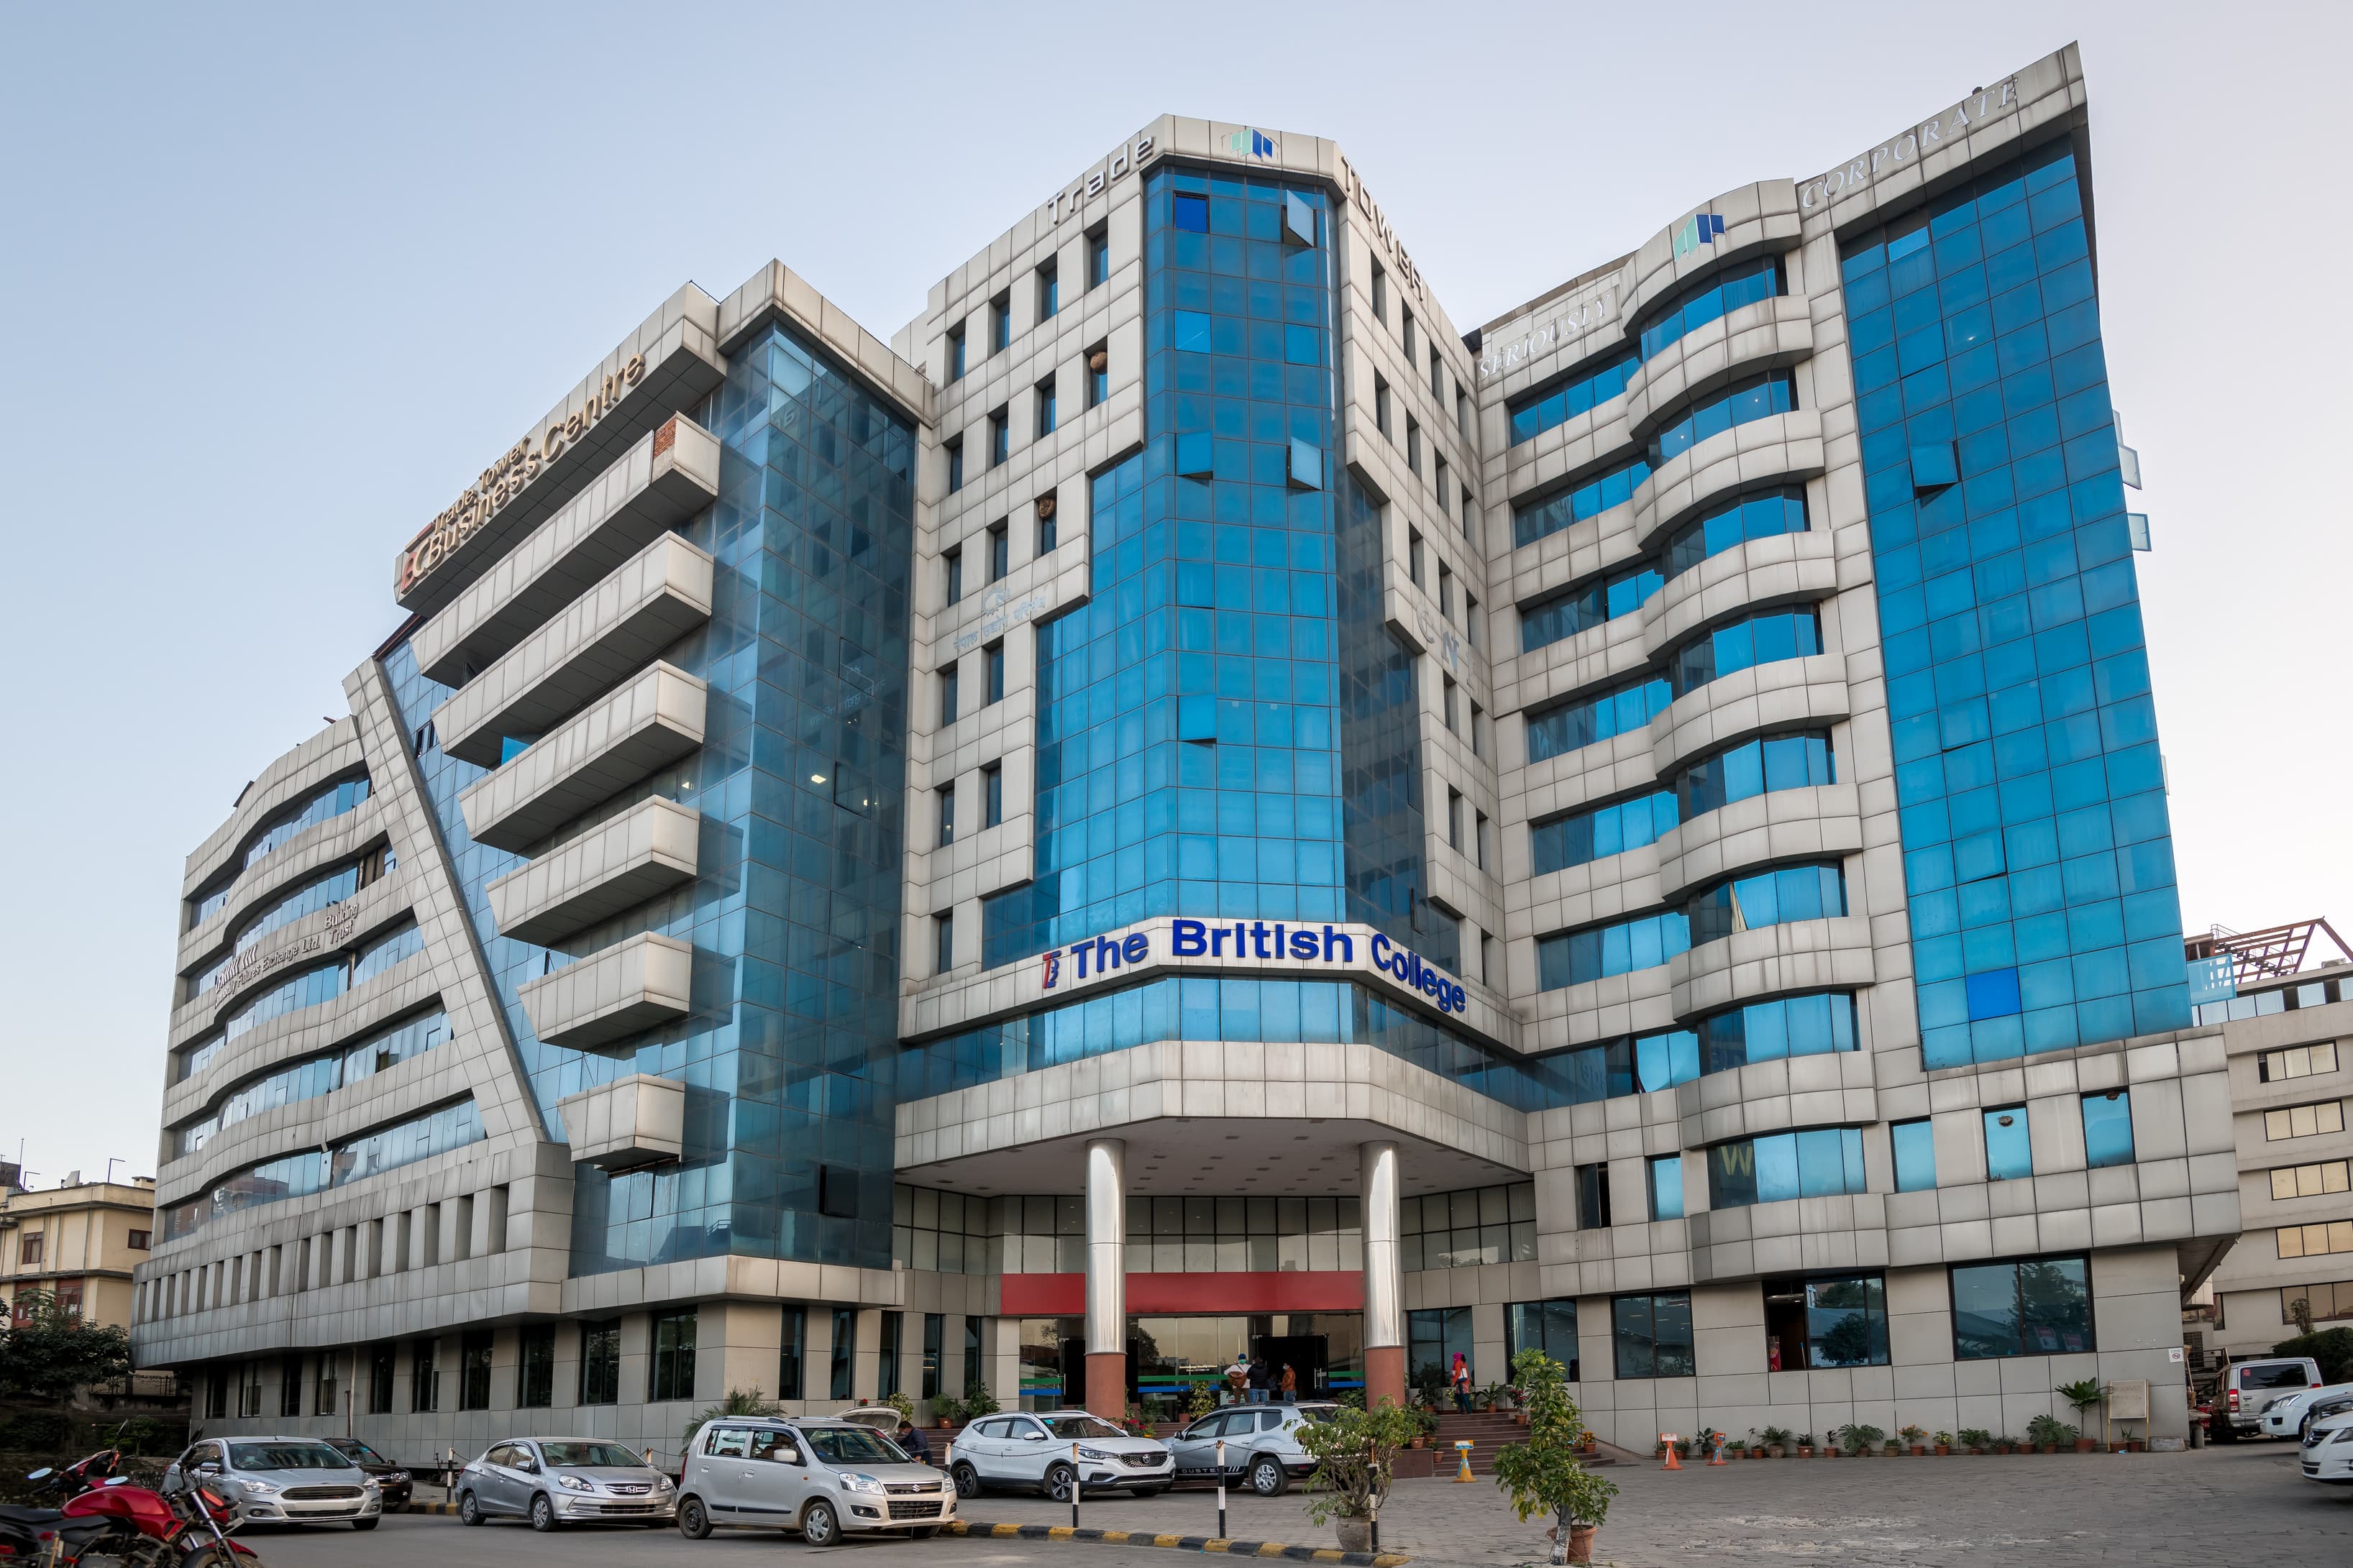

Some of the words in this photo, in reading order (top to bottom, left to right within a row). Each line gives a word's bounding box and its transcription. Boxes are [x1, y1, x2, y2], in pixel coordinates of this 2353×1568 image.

[1048, 136, 1154, 225] Trade
[1802, 77, 2019, 209] CORPORATE
[1341, 155, 1424, 302] TOWER
[1479, 293, 1611, 382] SERIOUSLY
[429, 449, 541, 572] Business
[540, 353, 646, 463] Centre
[433, 489, 478, 536] Trade
[479, 436, 531, 494] Tower
[262, 945, 299, 973] Exchange
[302, 935, 321, 954] Ltd.
[324, 902, 359, 930] Building
[329, 920, 354, 945] Trust
[1070, 932, 1148, 979] The
[1171, 919, 1353, 963] British
[1371, 932, 1466, 1013] College
